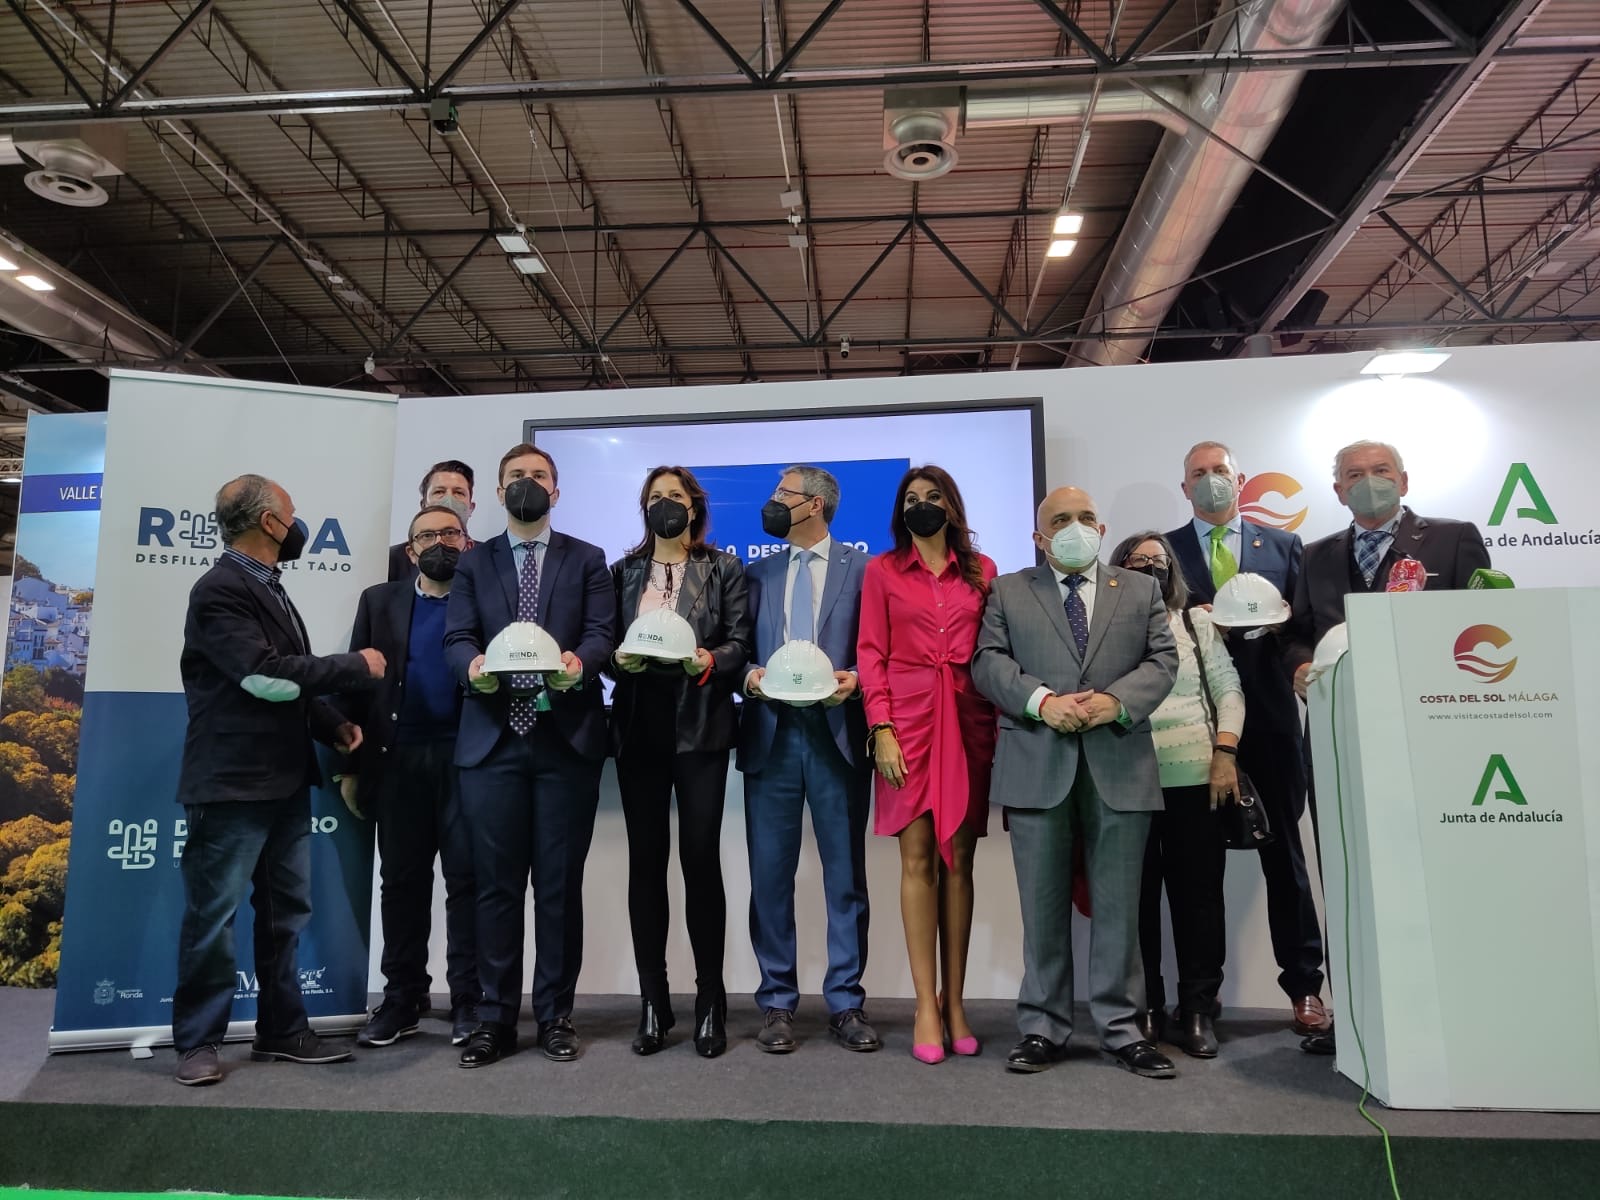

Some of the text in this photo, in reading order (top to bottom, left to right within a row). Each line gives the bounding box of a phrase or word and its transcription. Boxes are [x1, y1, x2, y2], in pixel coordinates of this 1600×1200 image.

[59, 485, 98, 500] VALLE
[1497, 533, 1517, 547] de
[1521, 529, 1600, 546] Andalucía
[308, 561, 351, 572] TAJO
[1420, 691, 1559, 704] COSTA DEL SOL MÁLAGA
[1428, 711, 1553, 720] www.visitacostadelsol.com
[1440, 809, 1563, 823] Junta de Andalucía
